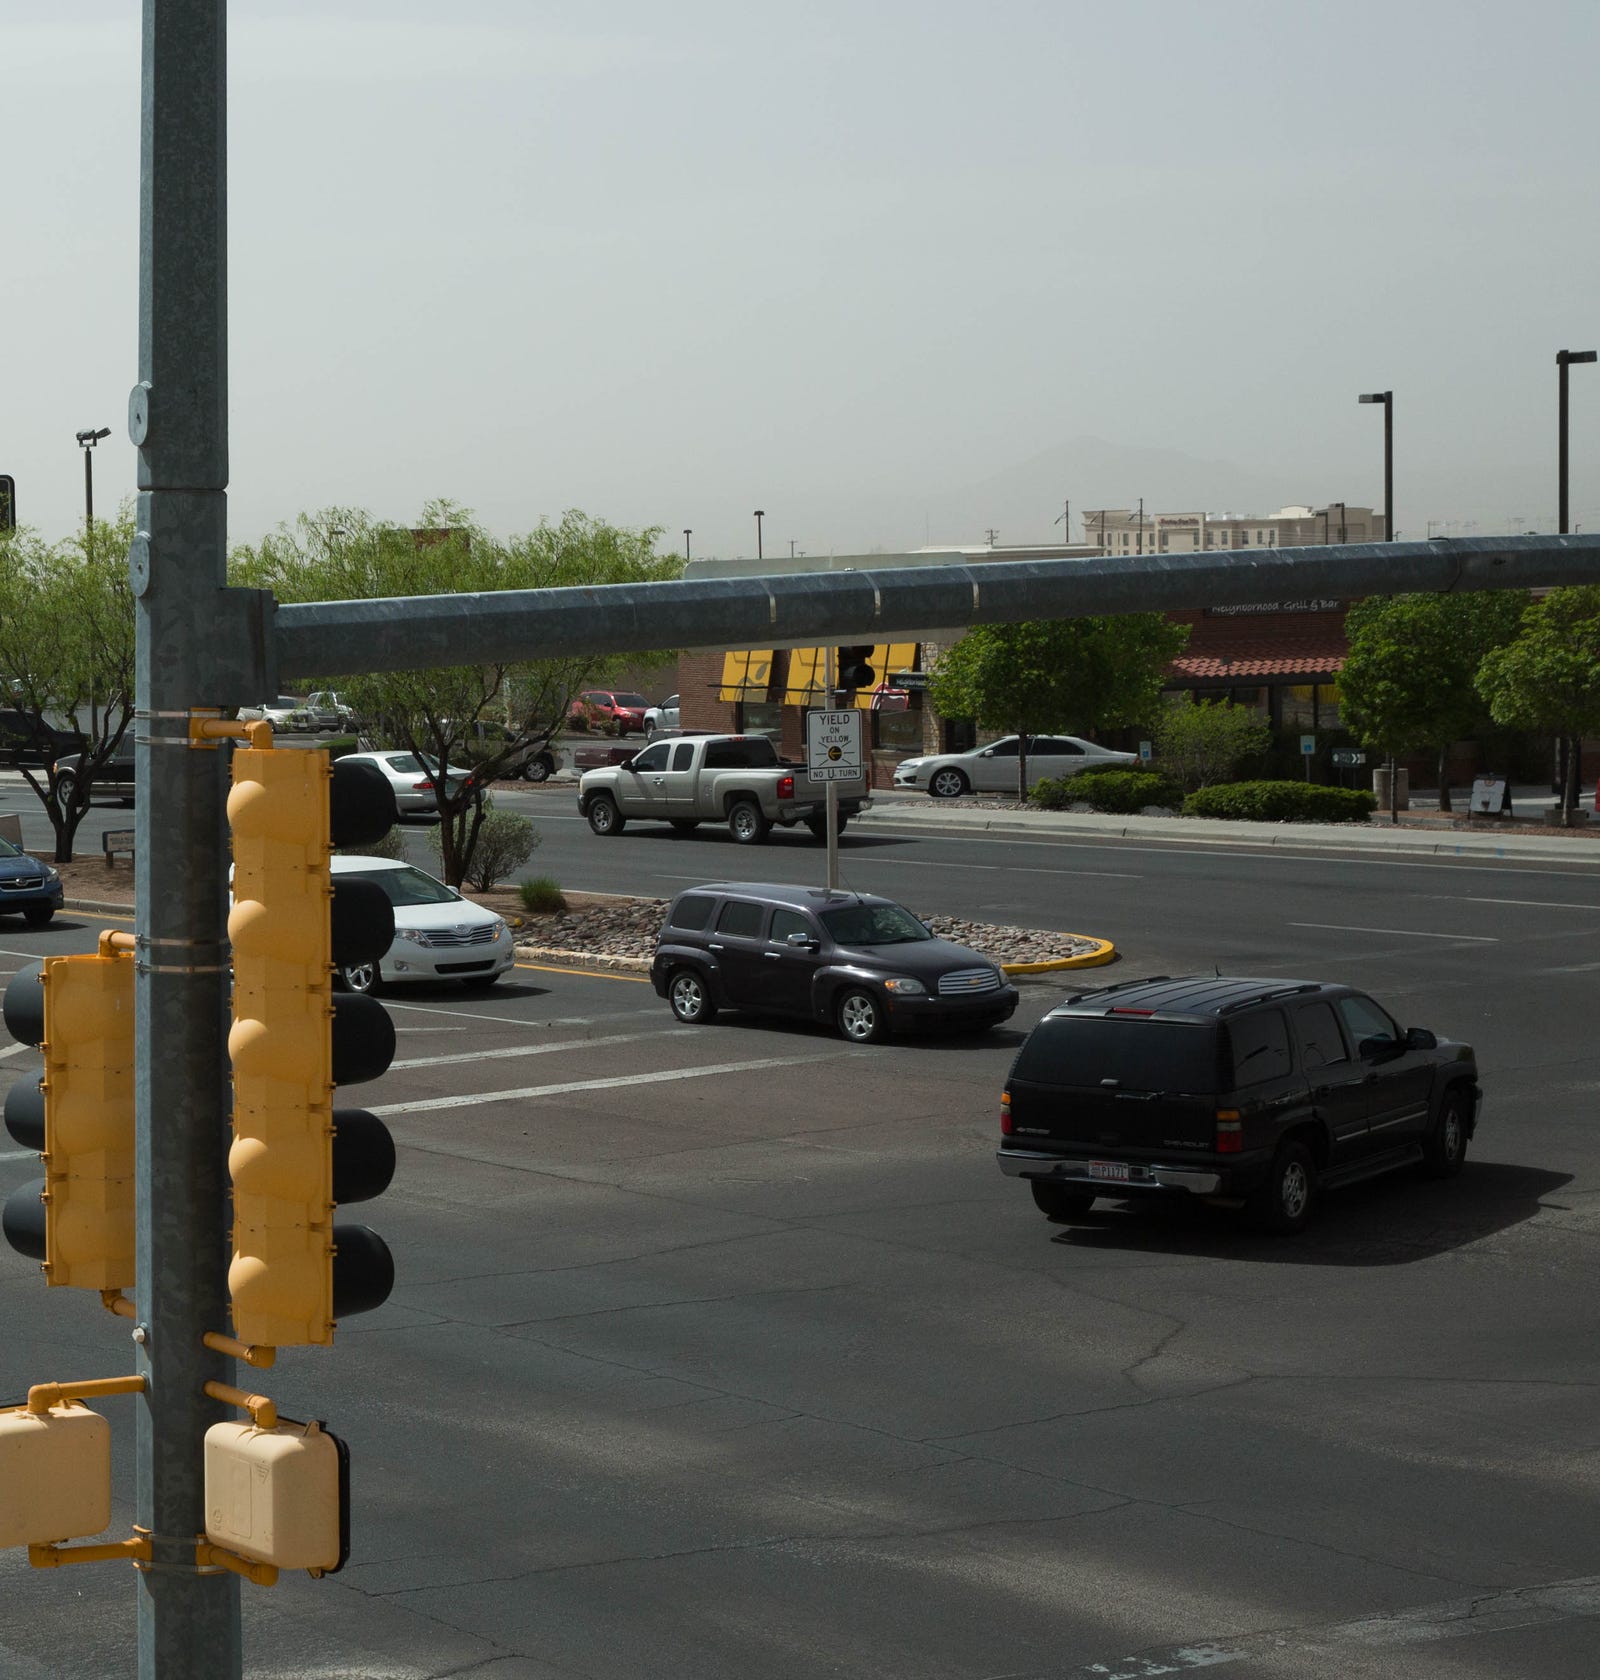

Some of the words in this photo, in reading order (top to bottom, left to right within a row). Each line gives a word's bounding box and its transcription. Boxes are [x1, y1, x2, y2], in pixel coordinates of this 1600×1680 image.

[1283, 601, 1308, 611] Grill
[1321, 600, 1339, 609] Bar
[820, 714, 850, 725] YIELD
[821, 735, 849, 743] YELLOW
[839, 769, 857, 777] TURN
